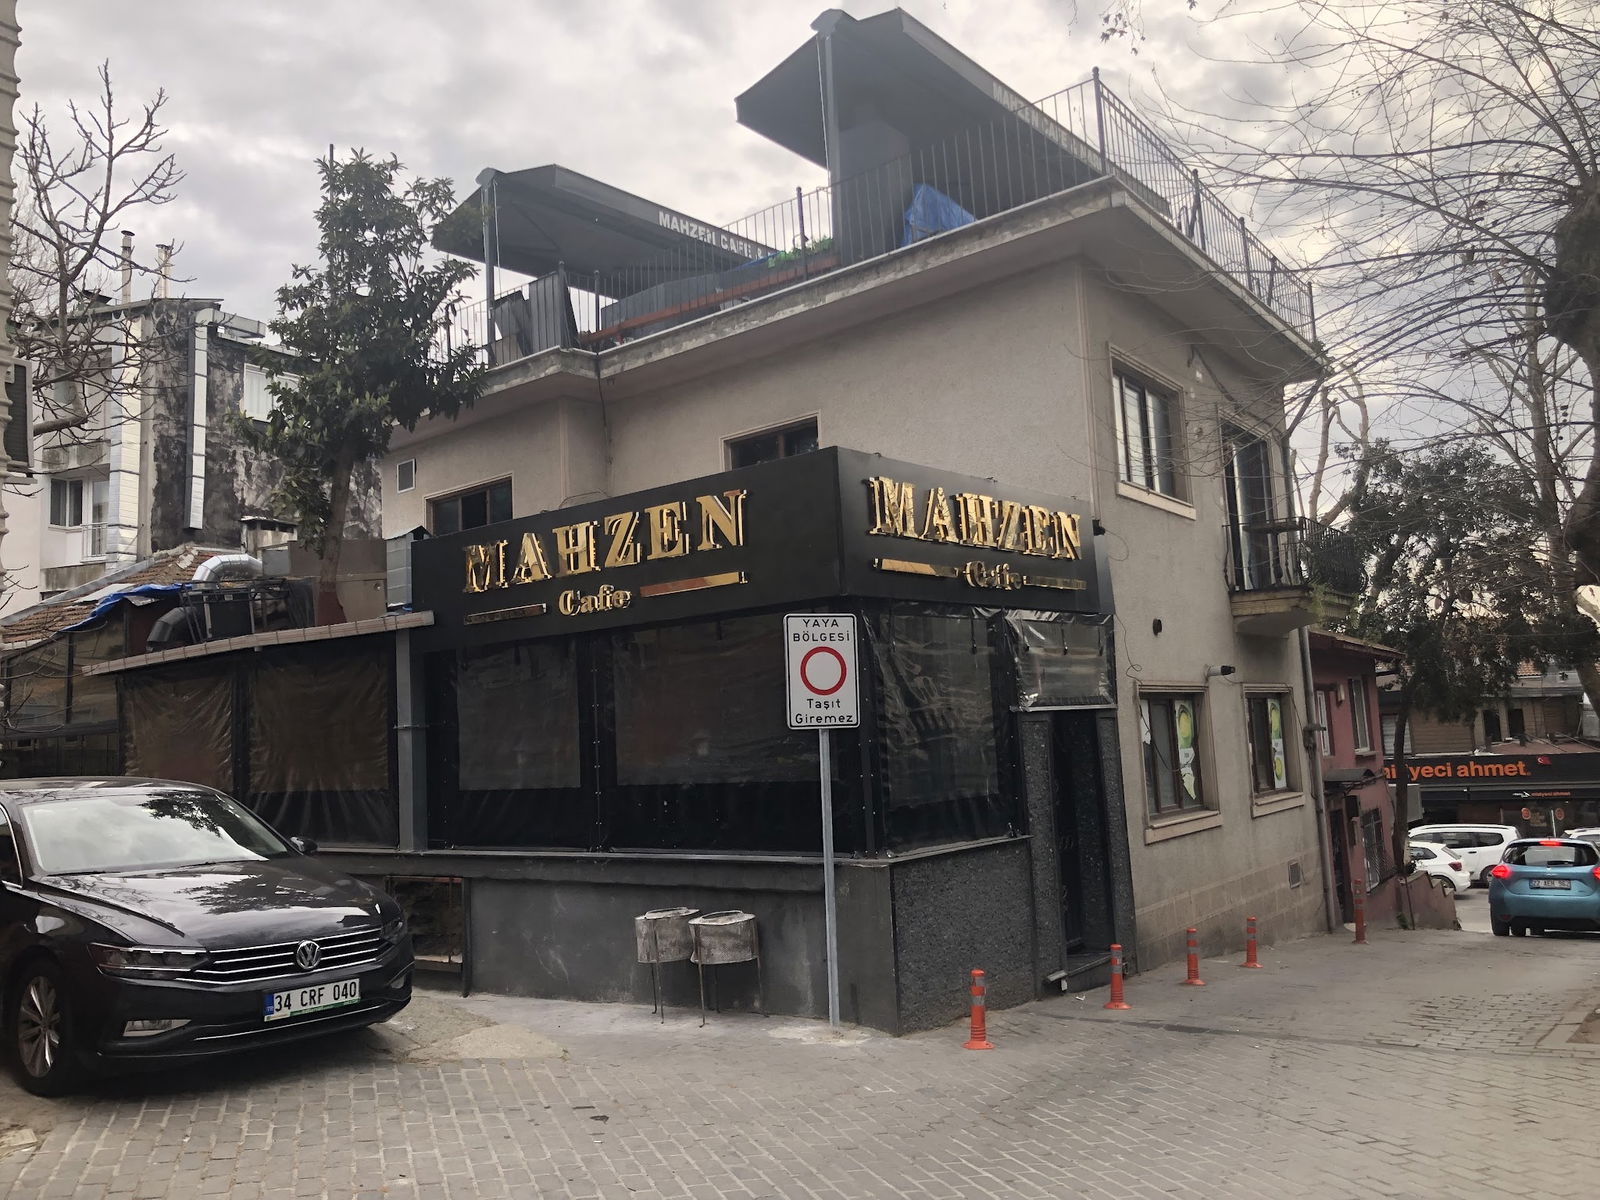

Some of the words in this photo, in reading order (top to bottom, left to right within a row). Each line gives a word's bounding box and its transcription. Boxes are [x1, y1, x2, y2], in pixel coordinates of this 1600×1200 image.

[658, 210, 717, 246] MAHZEN
[866, 476, 1082, 560] MAHZEN
[463, 488, 749, 594] MAHZEN
[558, 584, 632, 617] Cafe
[793, 630, 850, 642] BÖLGESİ
[802, 618, 840, 628] YAYA
[795, 713, 854, 724] Giremez
[806, 698, 841, 710] Taşıt
[275, 993, 291, 1012] 34
[301, 987, 325, 1006] CRF
[333, 982, 357, 1000] 040
